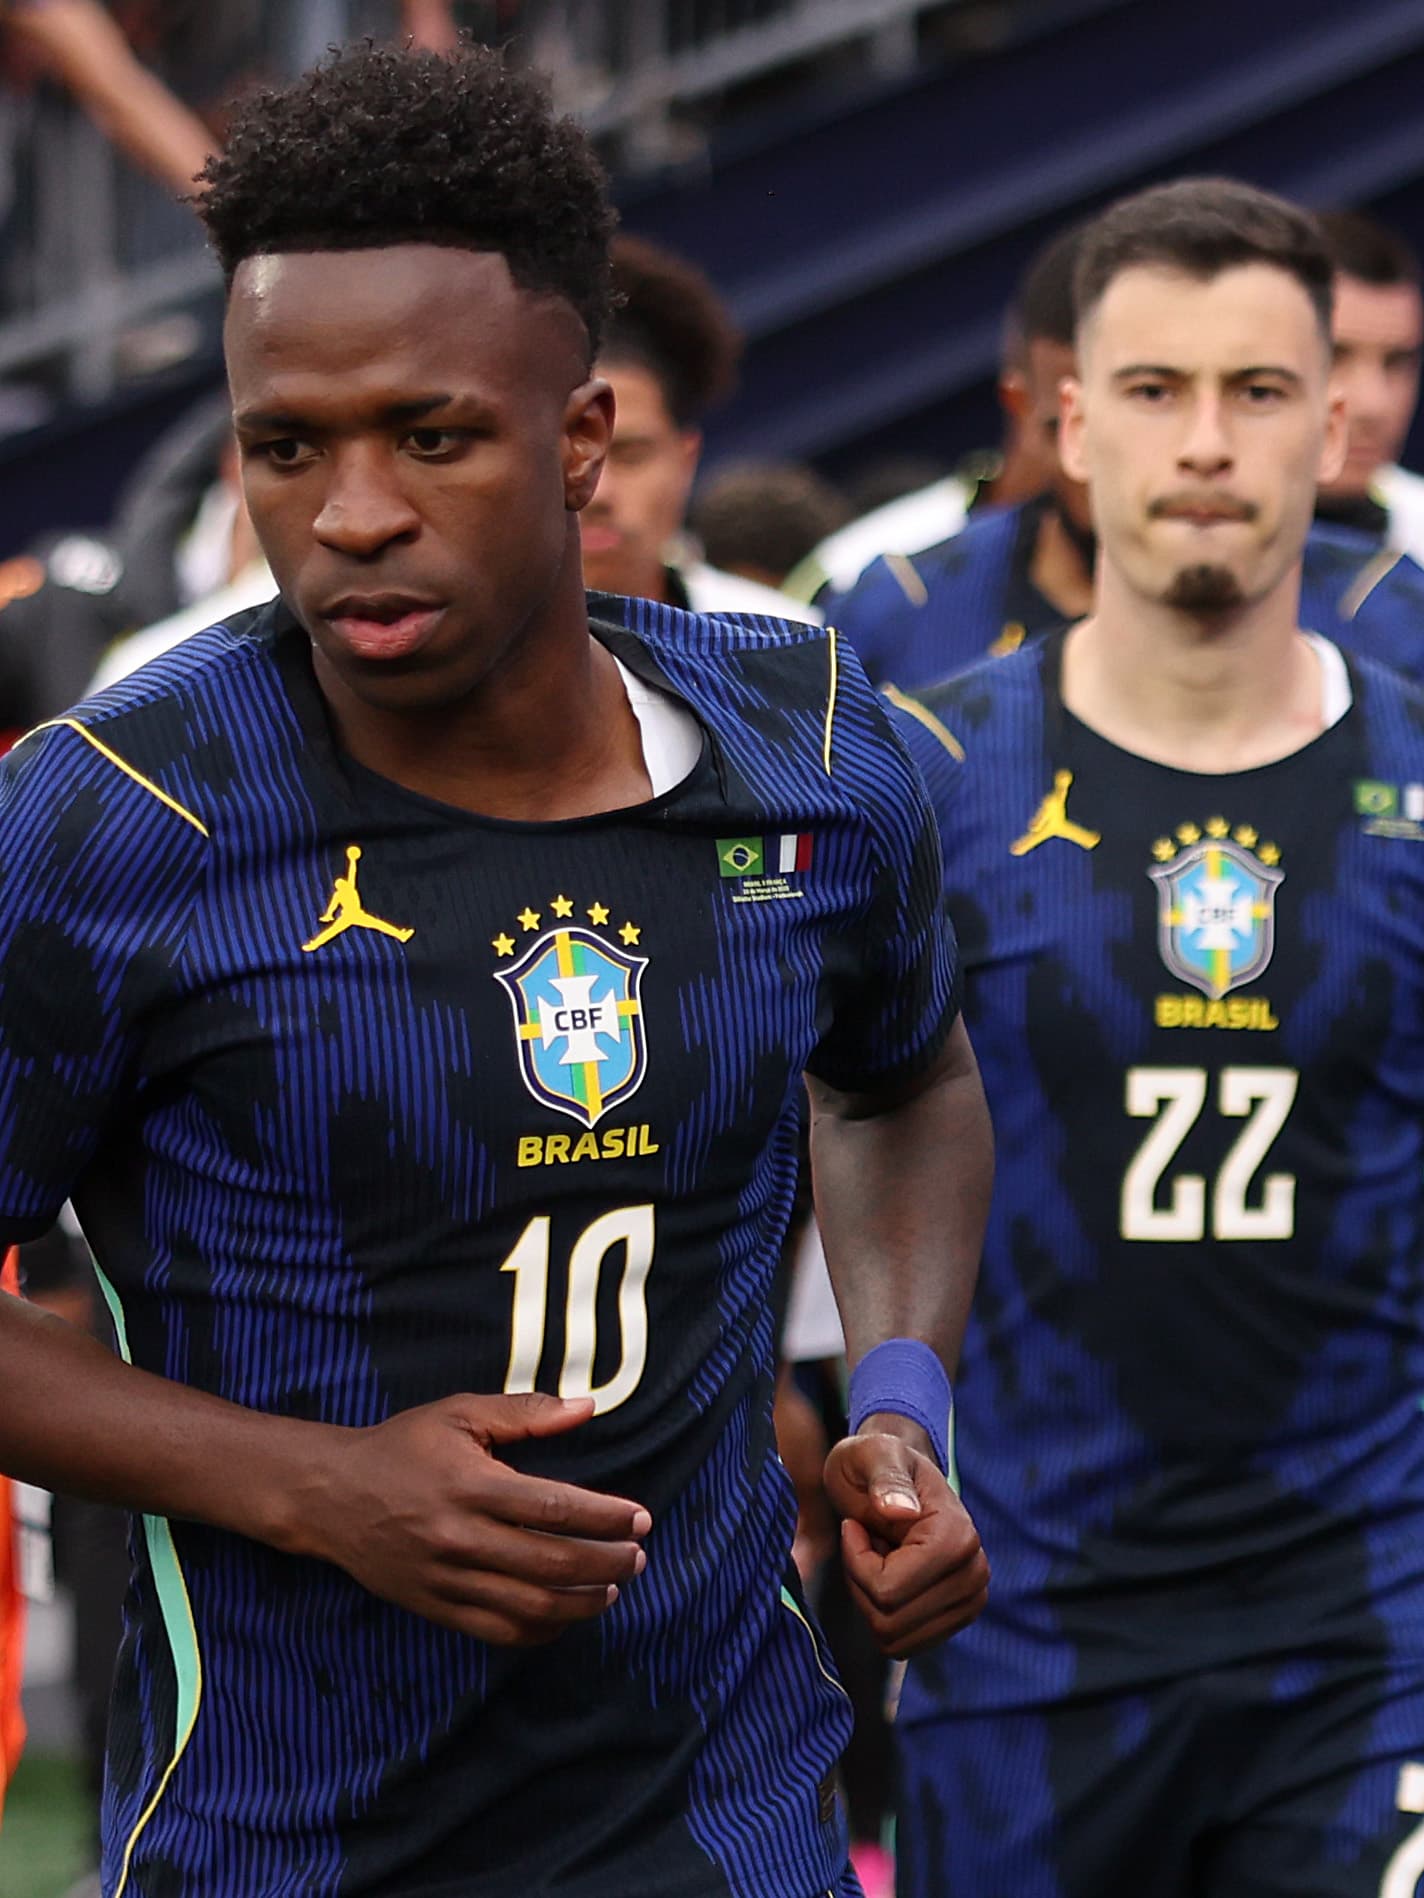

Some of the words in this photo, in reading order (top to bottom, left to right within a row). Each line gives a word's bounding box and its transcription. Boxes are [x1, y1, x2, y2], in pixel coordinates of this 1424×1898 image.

[553, 1007, 603, 1032] CBF
[1155, 996, 1279, 1030] BRASIL
[517, 1124, 660, 1168] BRASIL
[1119, 1066, 1299, 1242] 22
[500, 1204, 655, 1417] 10
